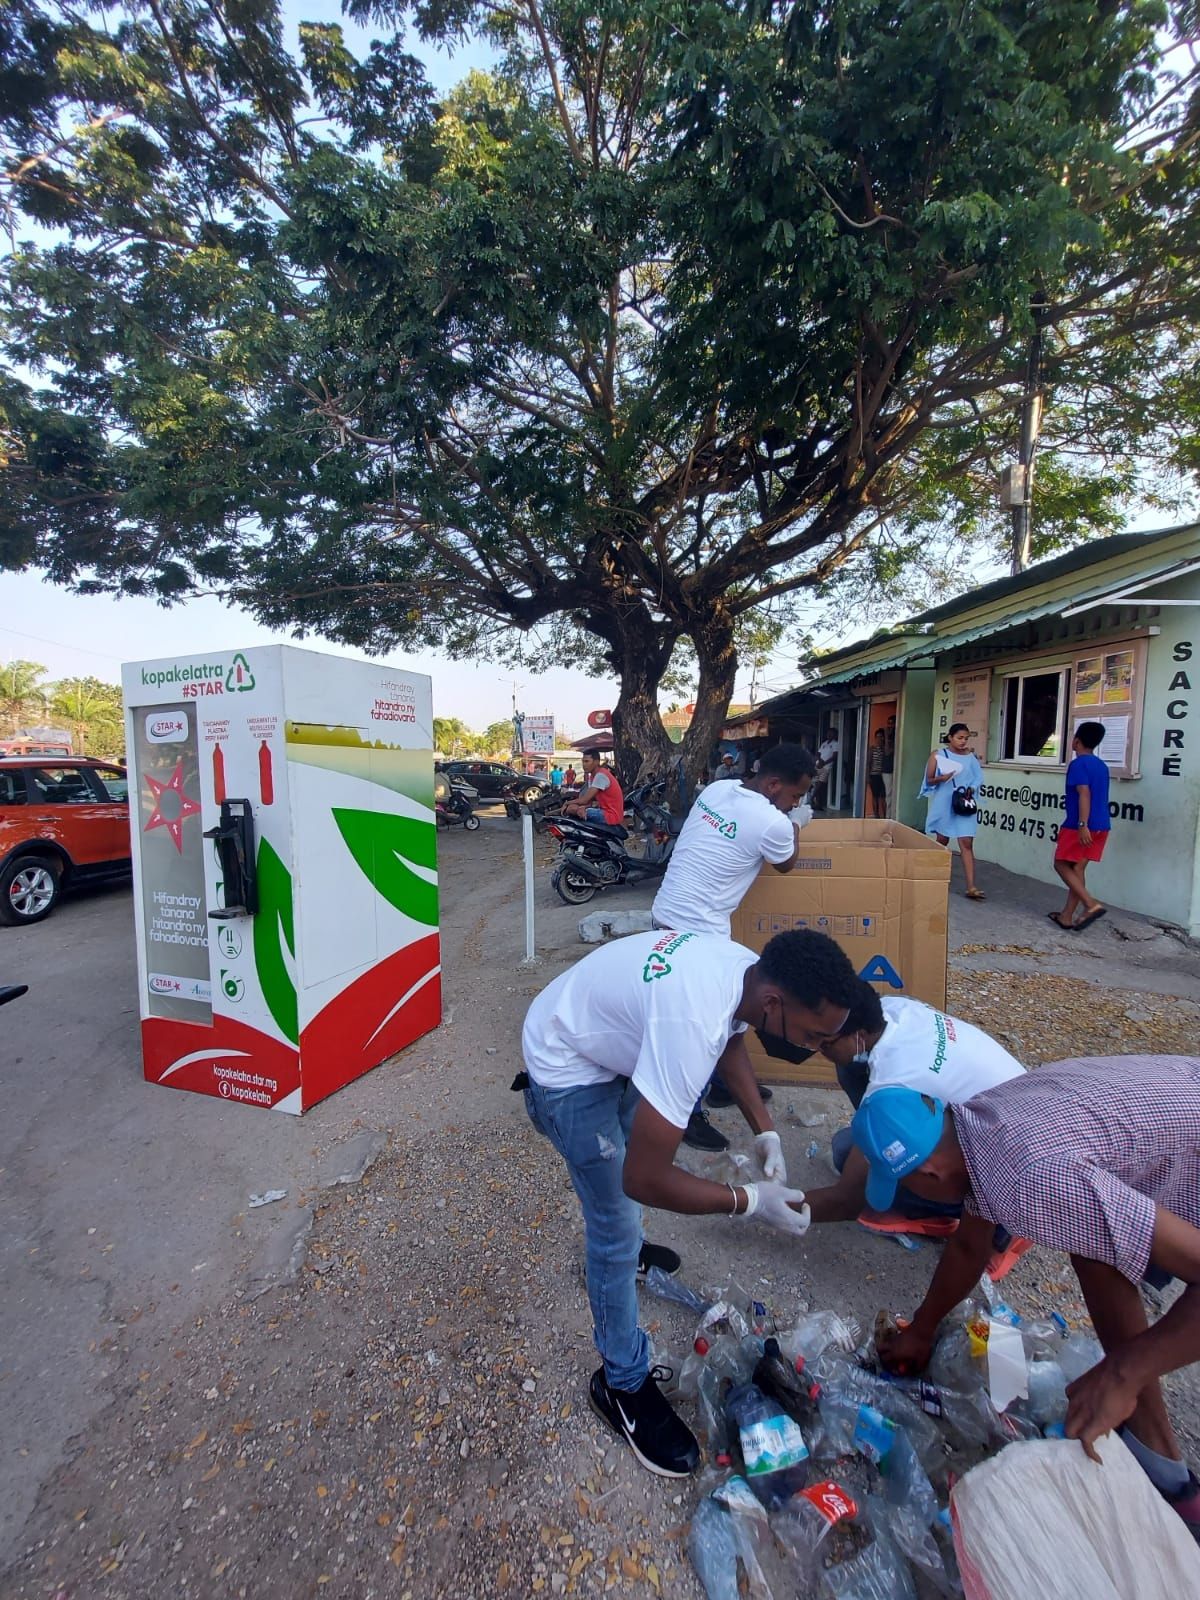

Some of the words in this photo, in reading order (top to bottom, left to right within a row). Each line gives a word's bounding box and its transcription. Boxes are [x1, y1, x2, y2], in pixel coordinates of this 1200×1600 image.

[141, 663, 224, 689] kopakelatra
[182, 681, 224, 698] #STAR
[1161, 641, 1193, 777] SACRÉ
[156, 722, 174, 731] STAR
[976, 809, 997, 828] 034
[1000, 813, 1015, 832] 29
[1019, 817, 1045, 839] 475
[155, 979, 171, 988] STAR
